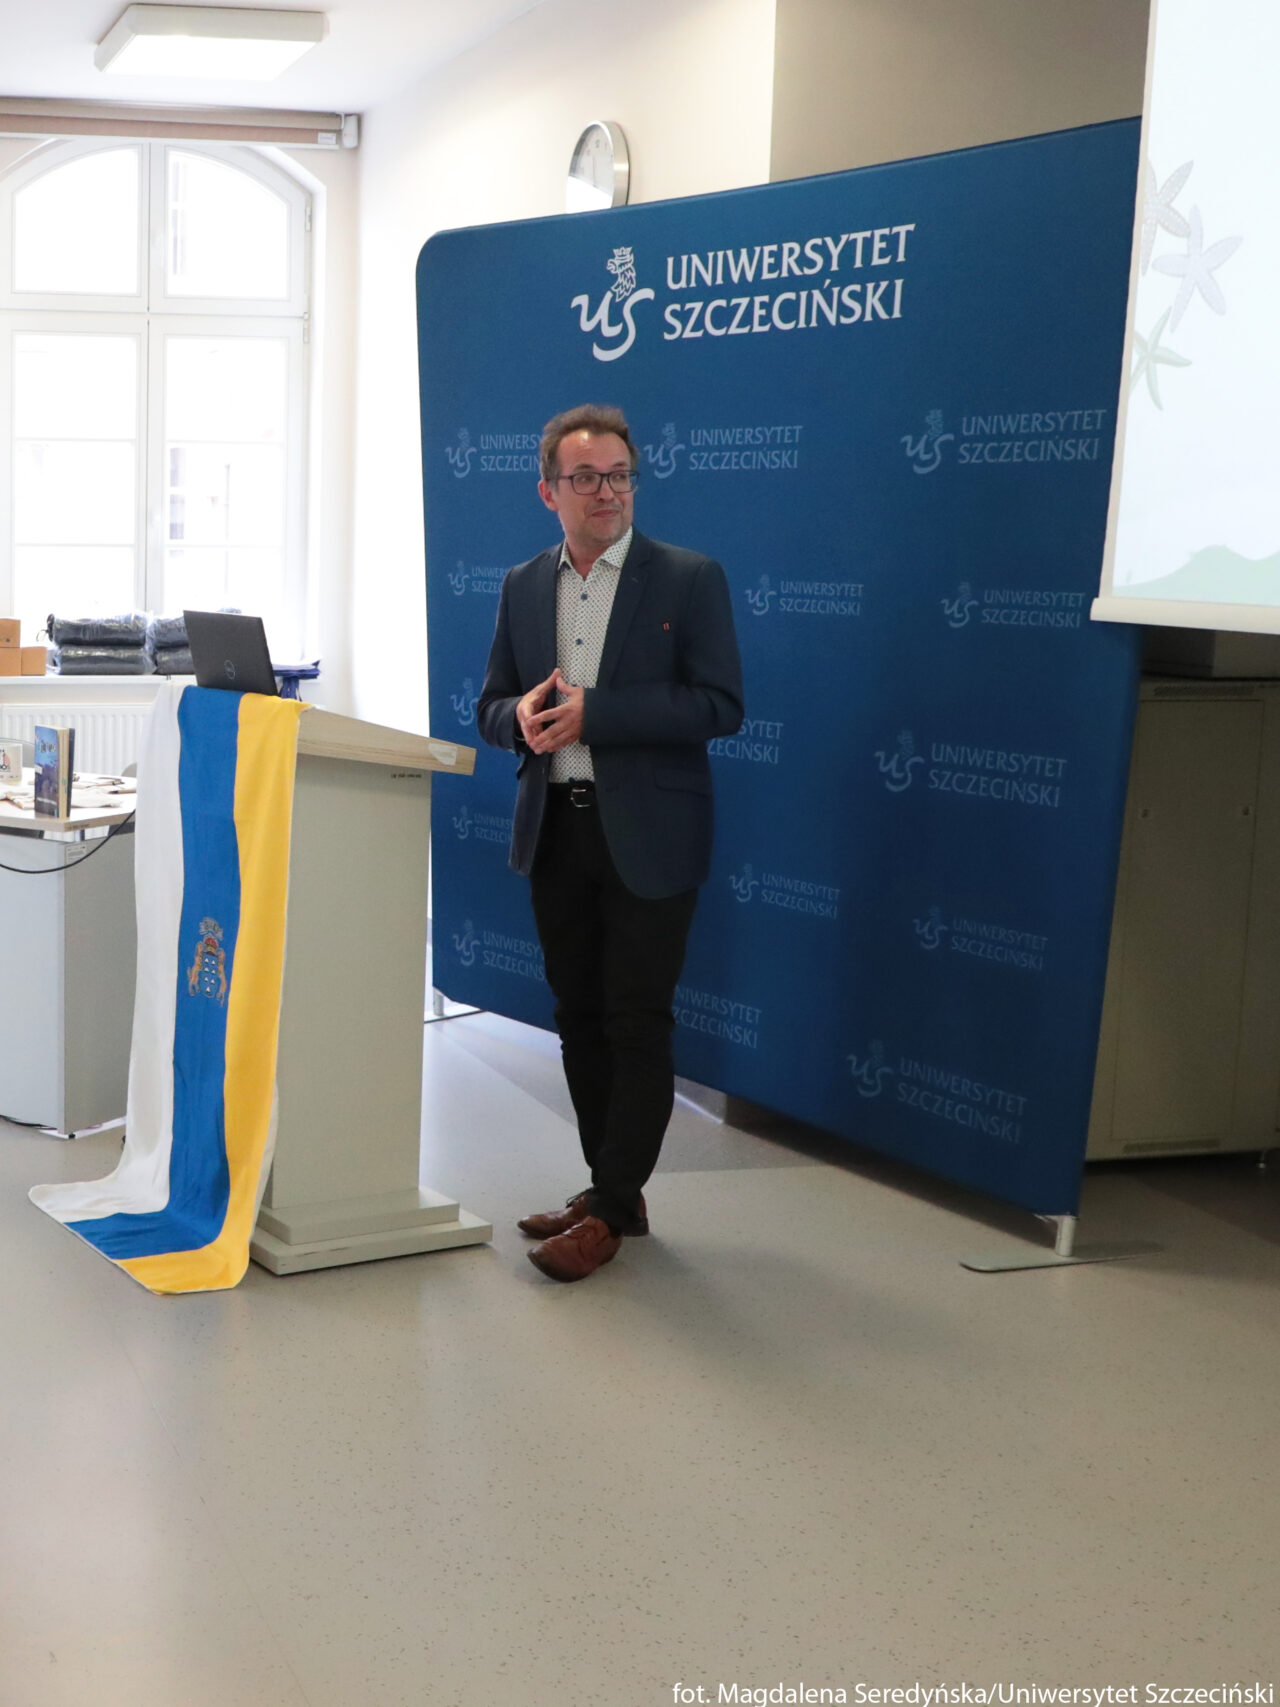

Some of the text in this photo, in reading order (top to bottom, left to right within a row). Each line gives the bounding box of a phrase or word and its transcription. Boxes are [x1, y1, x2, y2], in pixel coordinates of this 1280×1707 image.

[666, 223, 916, 290] UNIWERSYTET
[663, 279, 905, 341] SZCZECIŃSKI
[690, 426, 804, 446] UNIWERSYTET
[961, 409, 1107, 436] UNIWERSYTET
[689, 448, 799, 471] SZCZECIŃSKI
[958, 435, 1100, 464] SZCZECIŃSKI
[780, 580, 864, 598] UNIWERSYTET
[983, 589, 1086, 608] UNIWERSYTET
[931, 743, 1067, 779] UNIWERSYTET
[762, 873, 840, 902] UNIWERSYTET
[900, 1056, 1029, 1117] UNIWERSYTET
